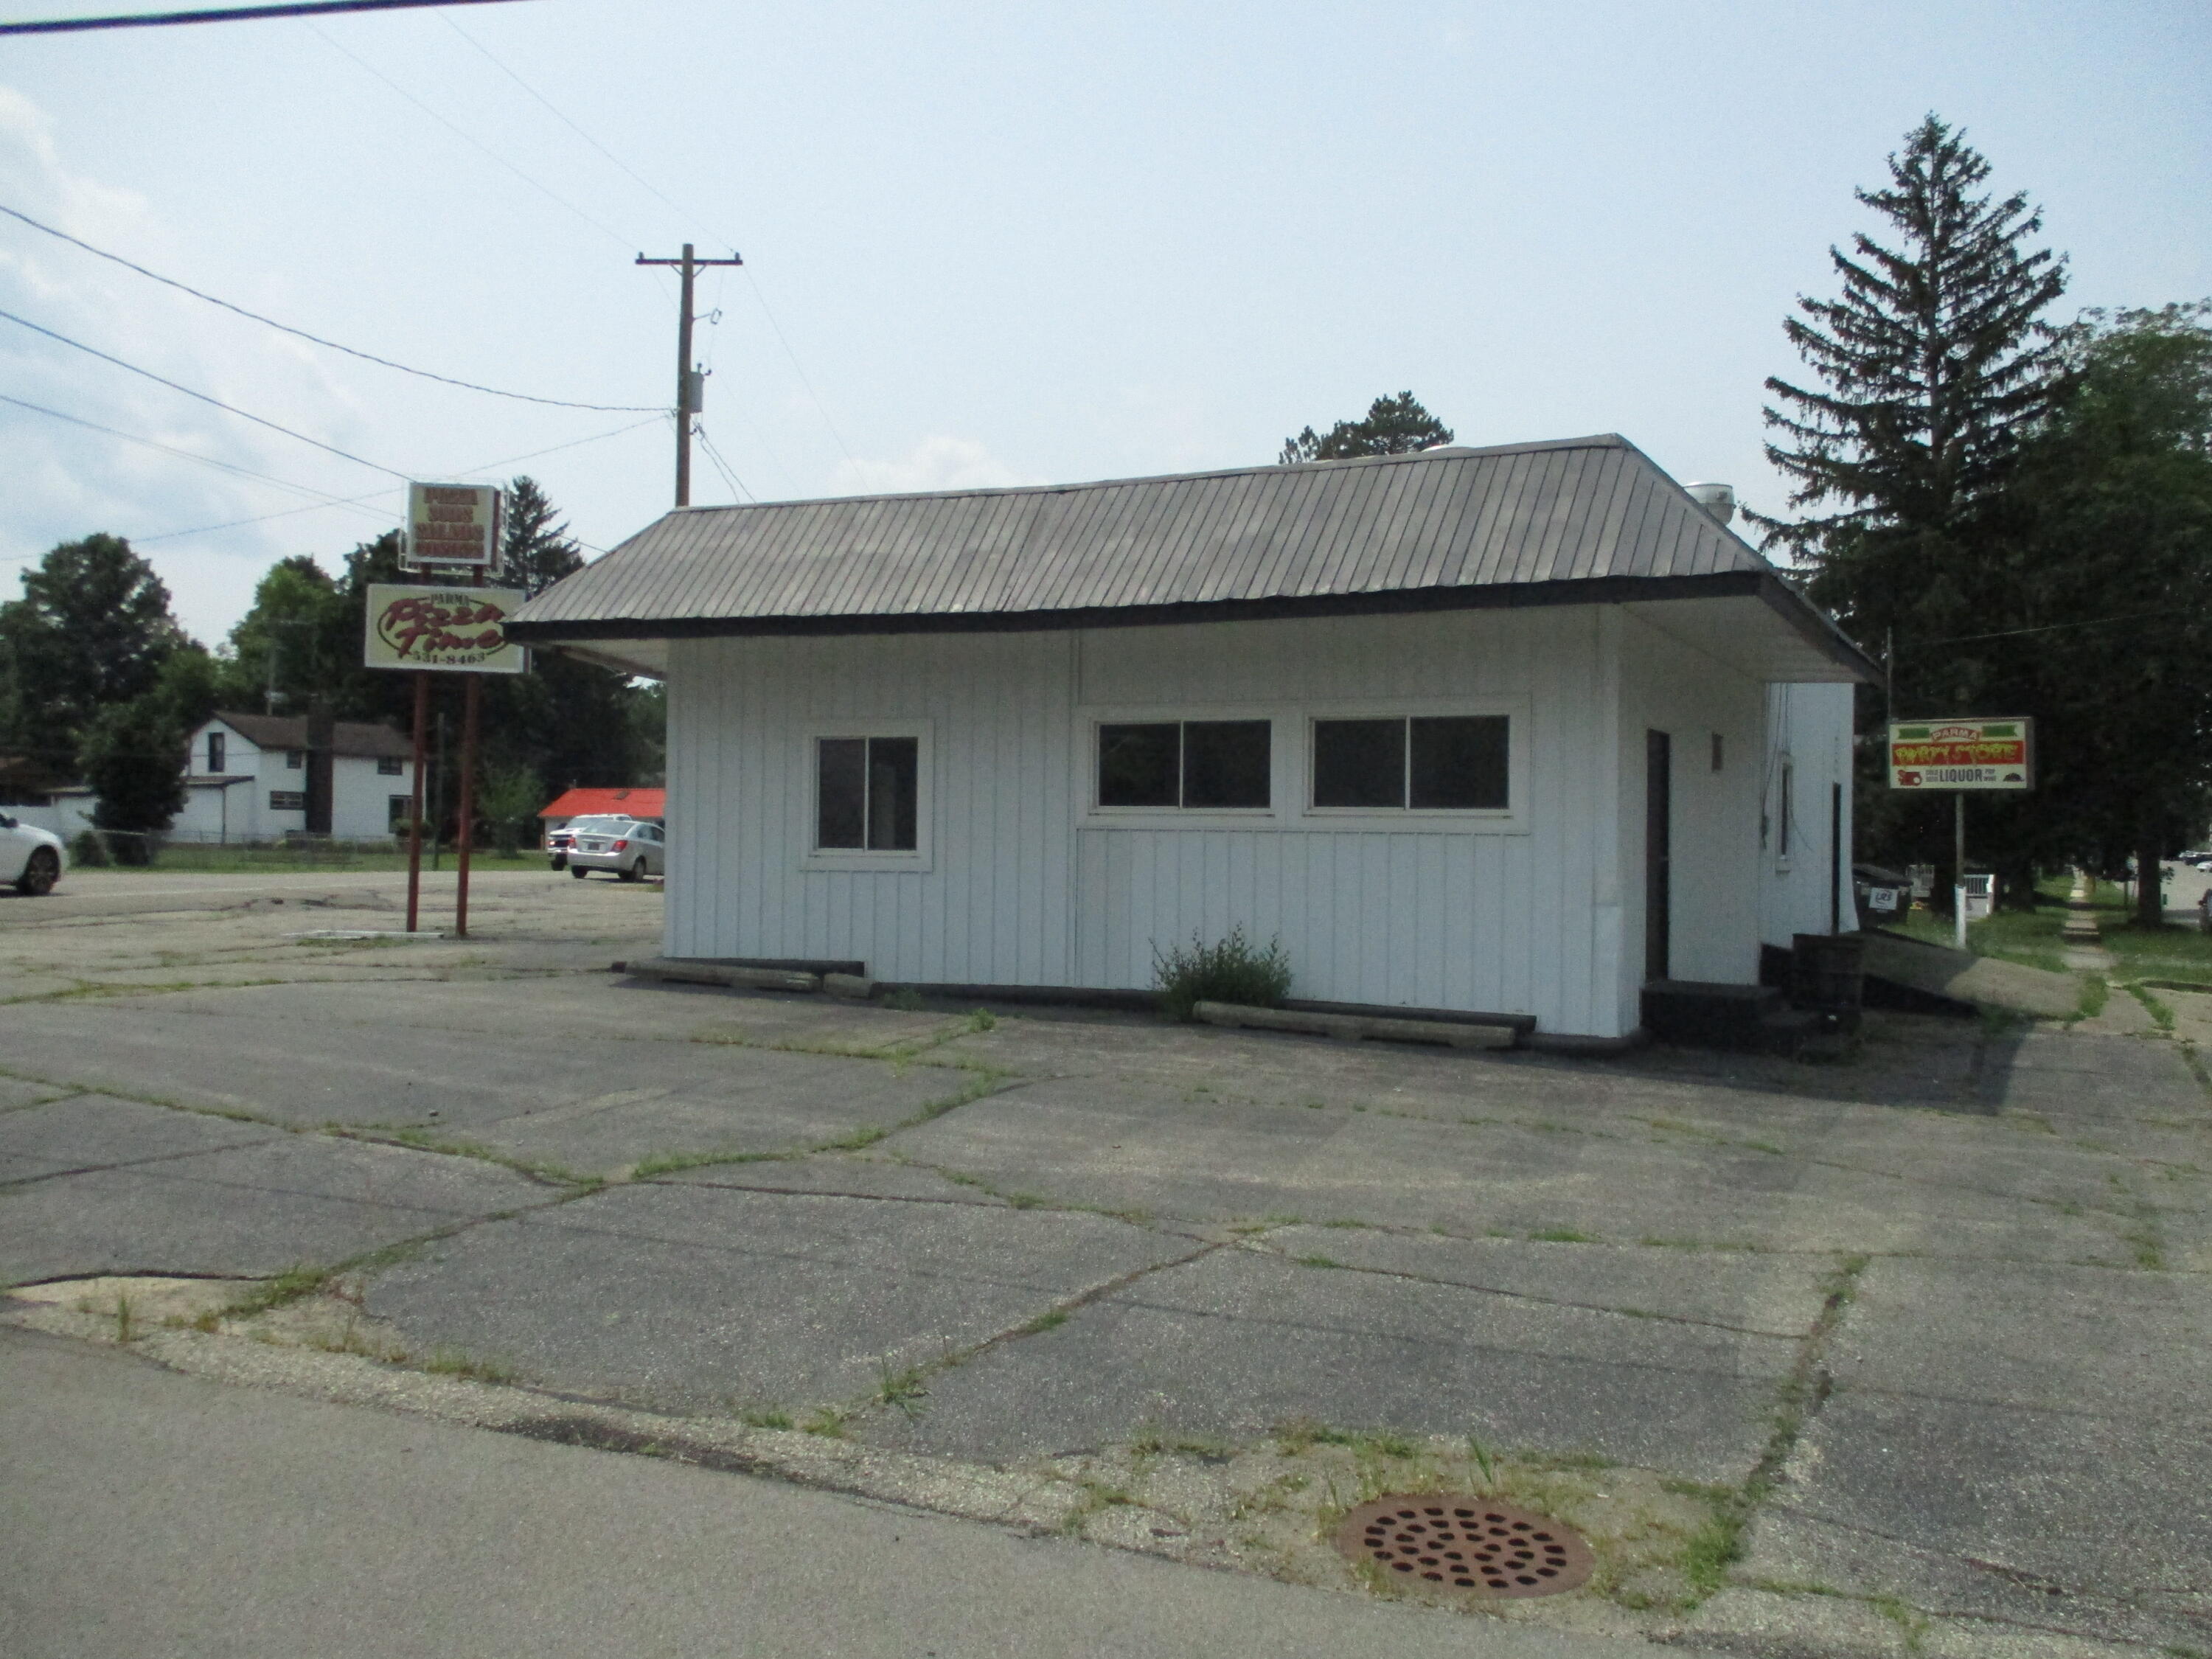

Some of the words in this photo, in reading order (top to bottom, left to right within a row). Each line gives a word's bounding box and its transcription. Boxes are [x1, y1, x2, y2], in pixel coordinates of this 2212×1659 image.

[430, 593, 470, 606] PARMA
[1933, 728, 1978, 741] PARMA
[1895, 745, 1950, 765] PARTY
[1953, 743, 2018, 765] STORE
[1939, 768, 1983, 782] LIQUOR
